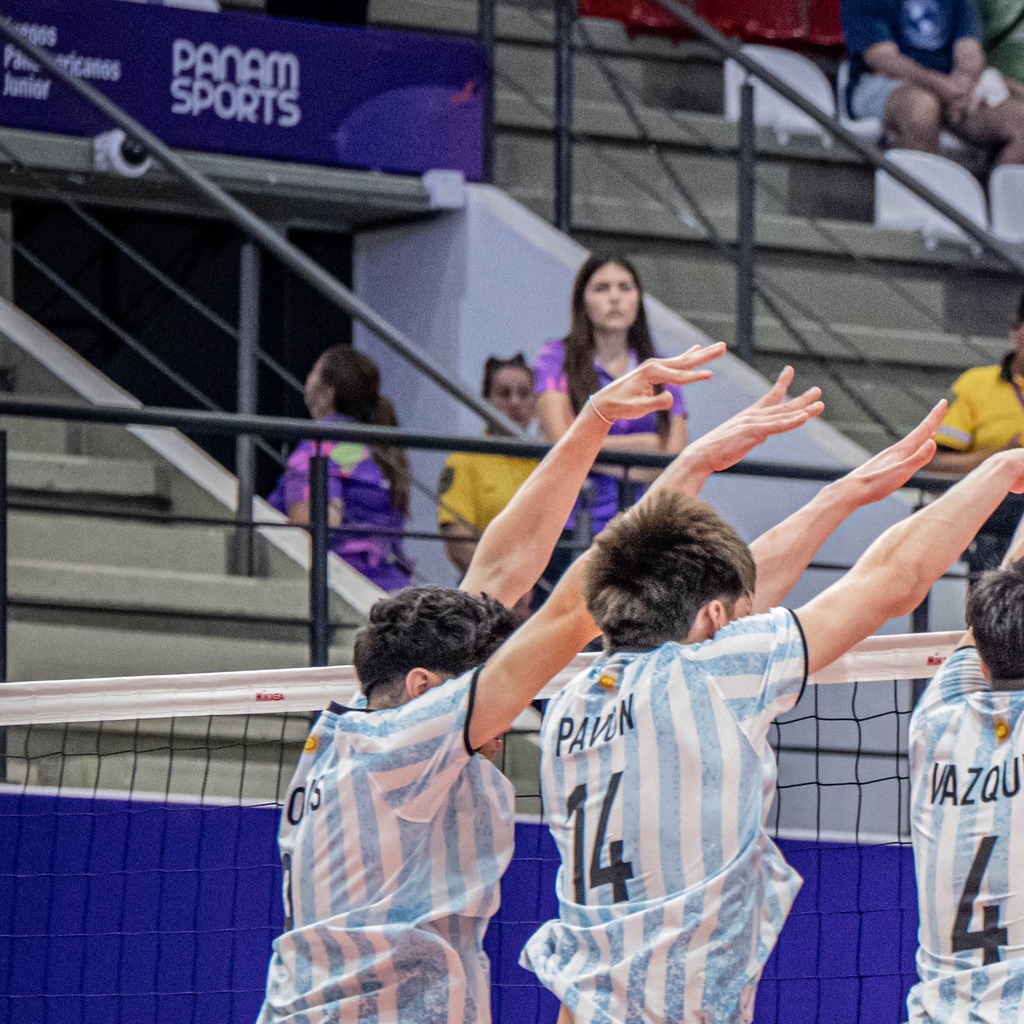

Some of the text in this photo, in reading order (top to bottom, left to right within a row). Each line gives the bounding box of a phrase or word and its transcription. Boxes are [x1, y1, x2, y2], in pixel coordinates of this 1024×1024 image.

[3, 70, 52, 100] Junior
[171, 38, 300, 88] PANAM
[170, 76, 301, 127] SPORTS
[566, 771, 634, 905] 14
[952, 836, 1008, 966] 4
